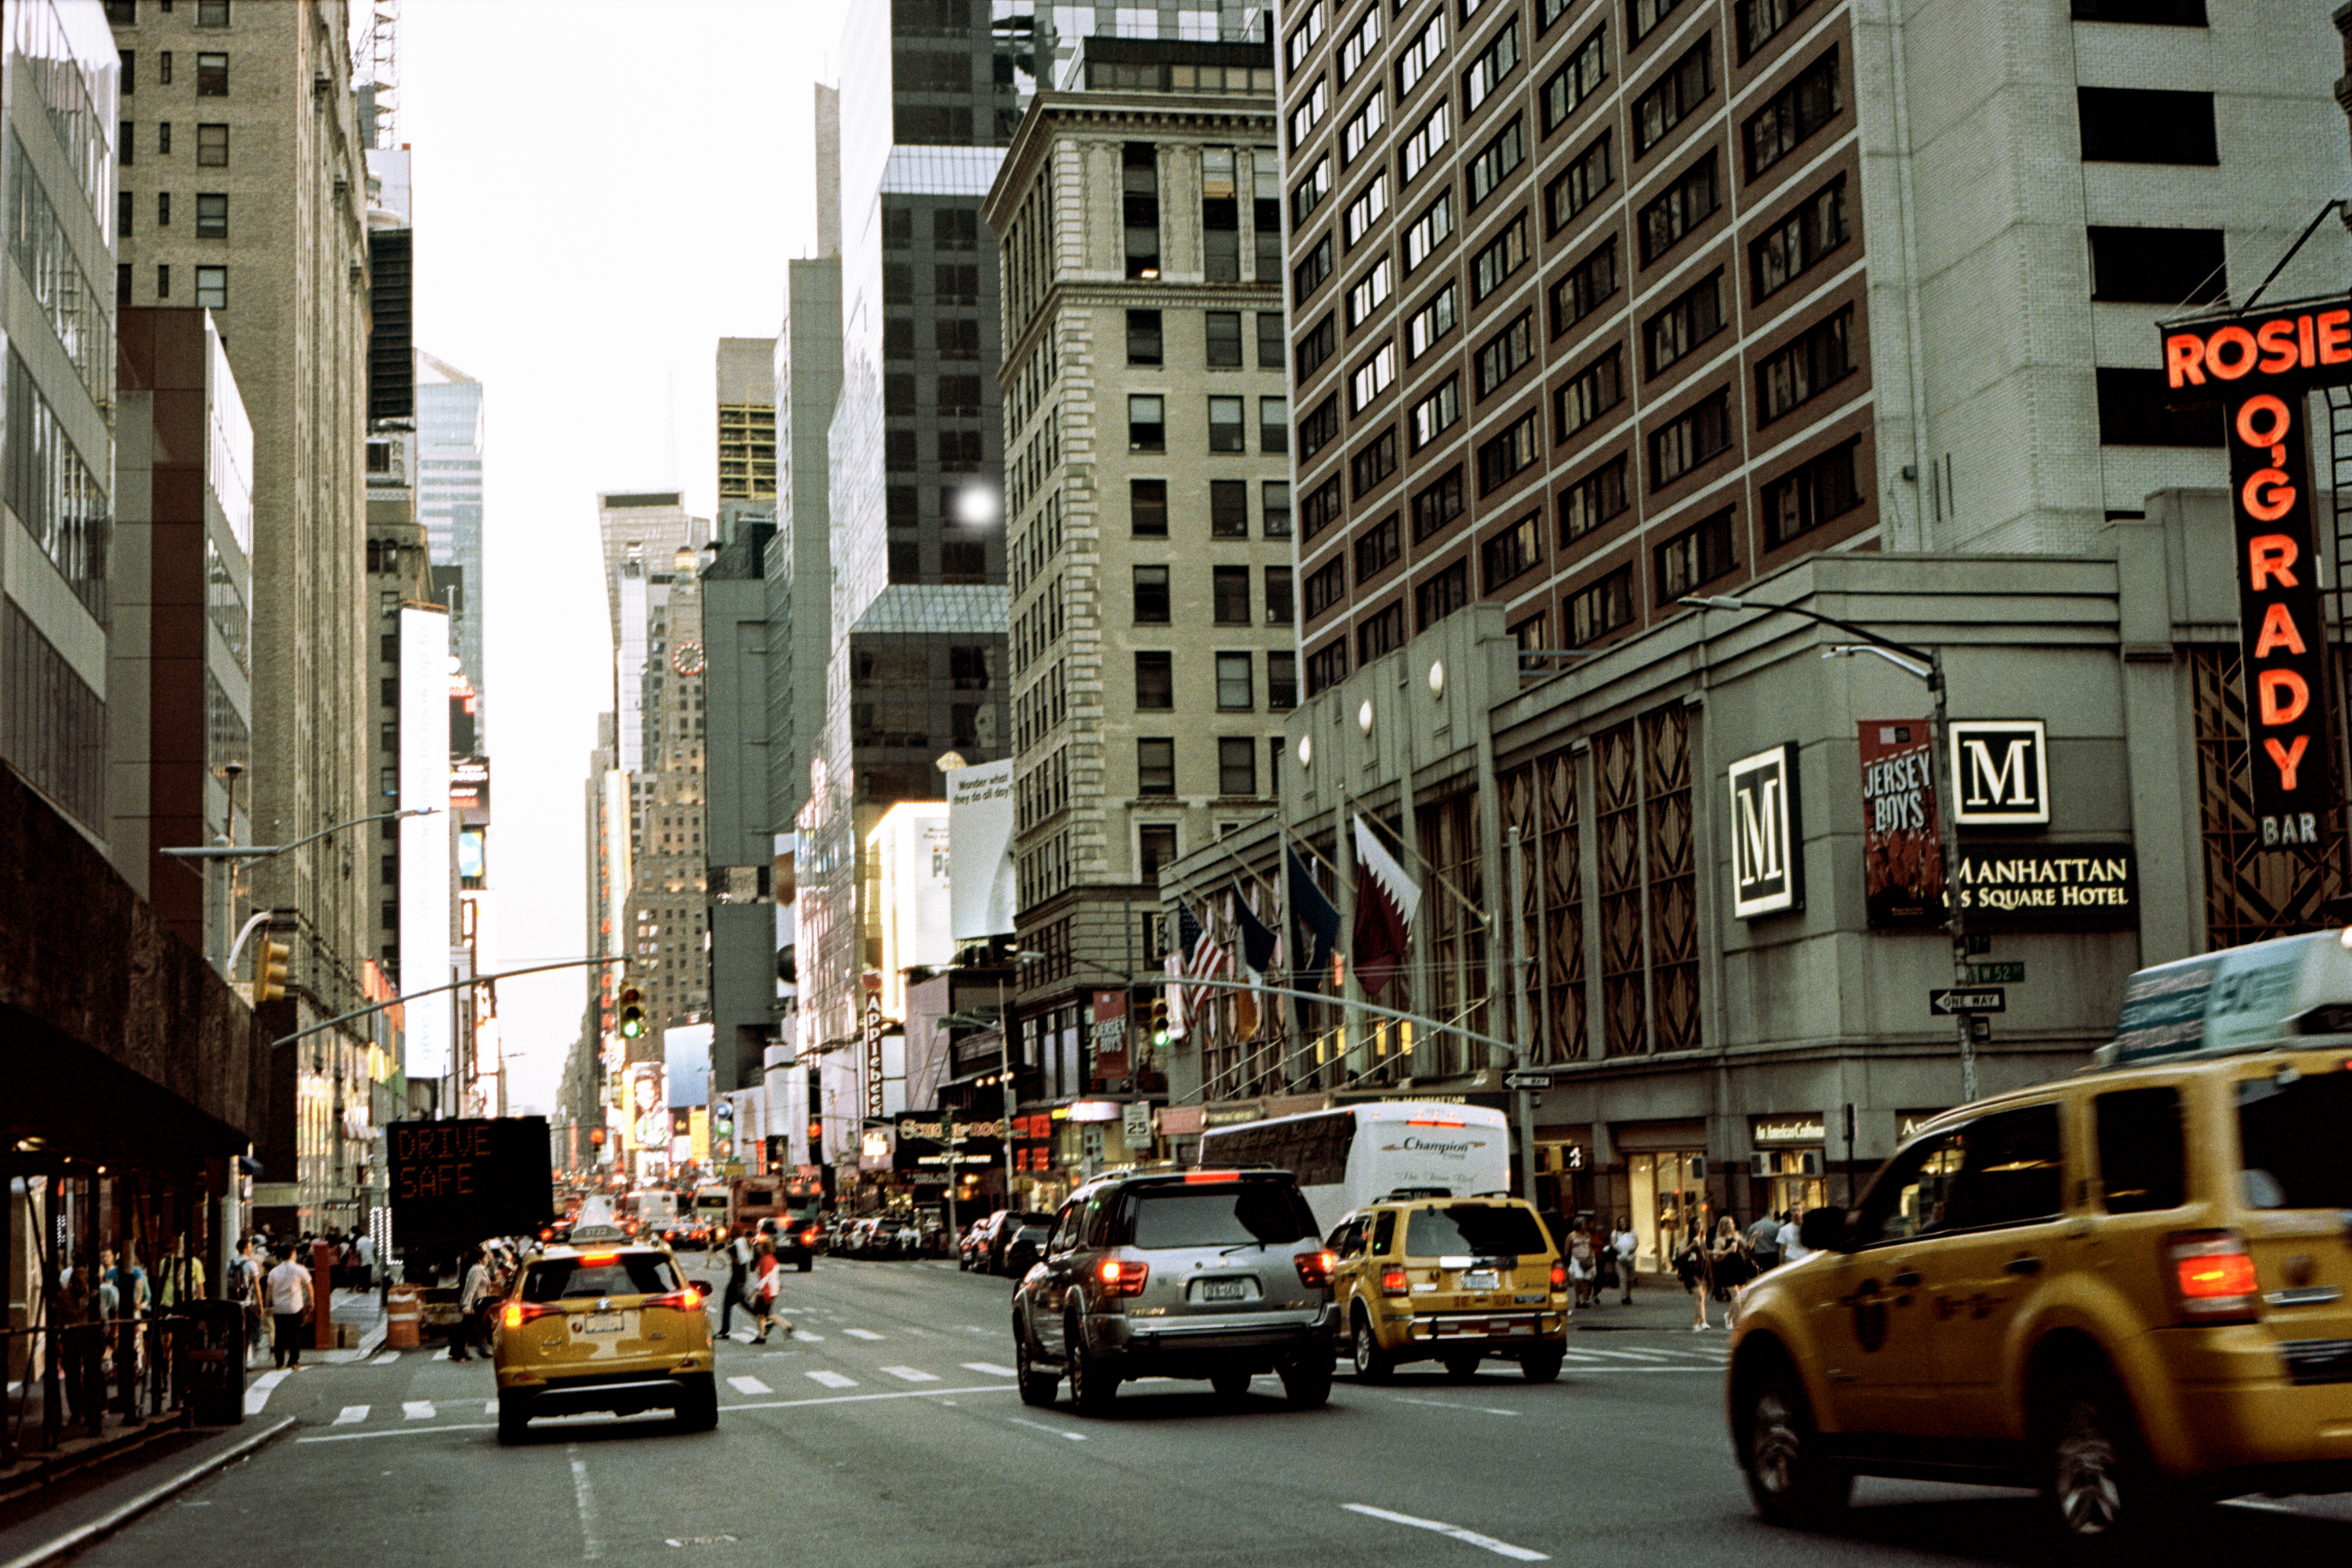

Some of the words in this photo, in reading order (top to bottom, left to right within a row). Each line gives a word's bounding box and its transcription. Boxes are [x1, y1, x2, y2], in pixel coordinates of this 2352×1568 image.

[2168, 309, 2352, 389] ROSIE
[2236, 393, 2310, 791] O'GRADY
[1864, 751, 1931, 799] JERSEY
[1963, 740, 2035, 805] M
[971, 790, 981, 802] do
[1875, 790, 1925, 832] BOYS
[1737, 778, 1783, 887] M
[2262, 813, 2318, 847] BAR
[1978, 887, 2056, 910] SQUARE
[2061, 885, 2129, 906] HOTEL
[1981, 966, 1991, 981] W
[1995, 966, 2010, 980] 52
[1943, 996, 1964, 1008] ONE
[1972, 995, 1995, 1006] WAY
[398, 1125, 491, 1161] DRIVE
[1127, 1121, 1147, 1134] 25
[1403, 1136, 1468, 1154] Champion
[400, 1162, 475, 1199] SAFE
